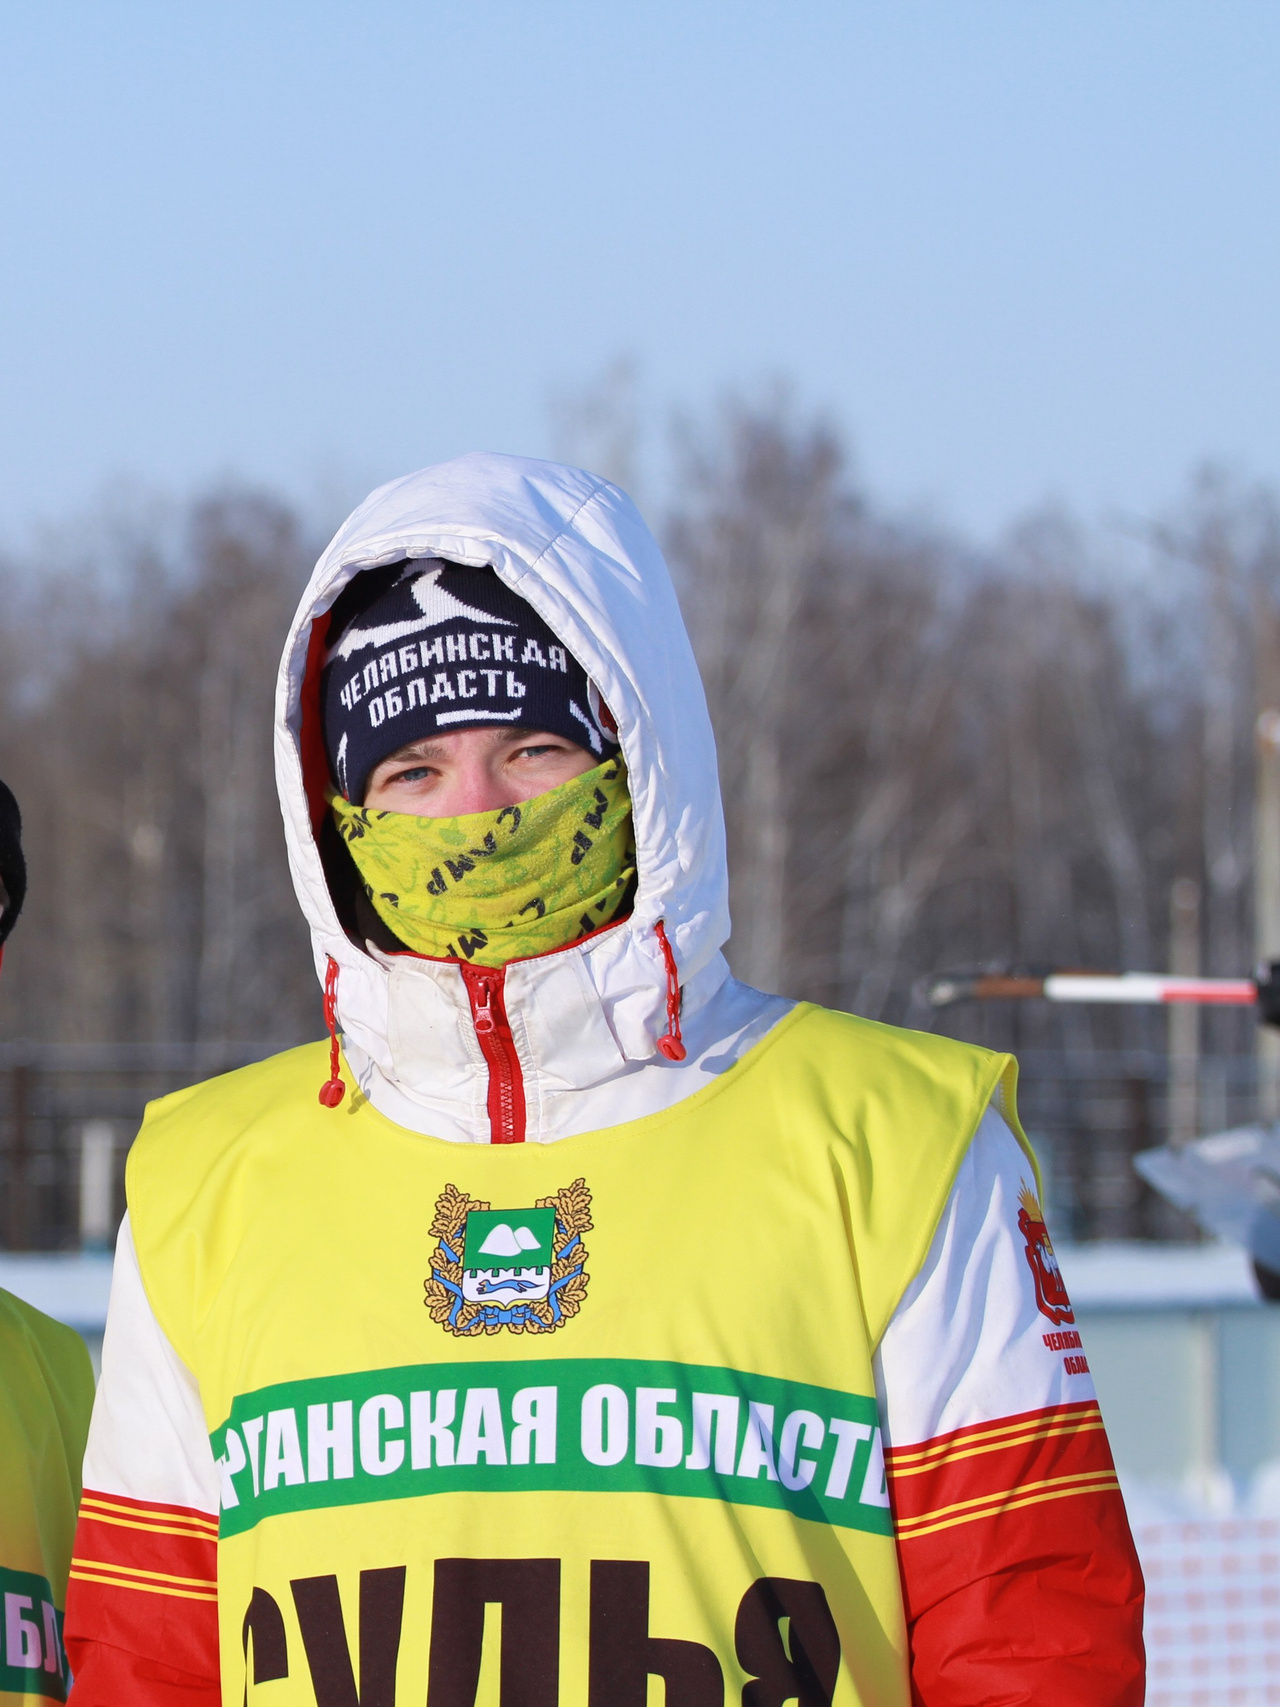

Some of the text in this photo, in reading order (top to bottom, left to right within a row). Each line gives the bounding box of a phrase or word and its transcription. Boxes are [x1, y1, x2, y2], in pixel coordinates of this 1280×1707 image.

[339, 632, 568, 711] ЧЕЛЯБИНСКАЯ
[367, 669, 527, 728] ОБЛАСТЬ
[426, 806, 522, 896] CAMP
[214, 1386, 558, 1510] РГАНСКАЯ
